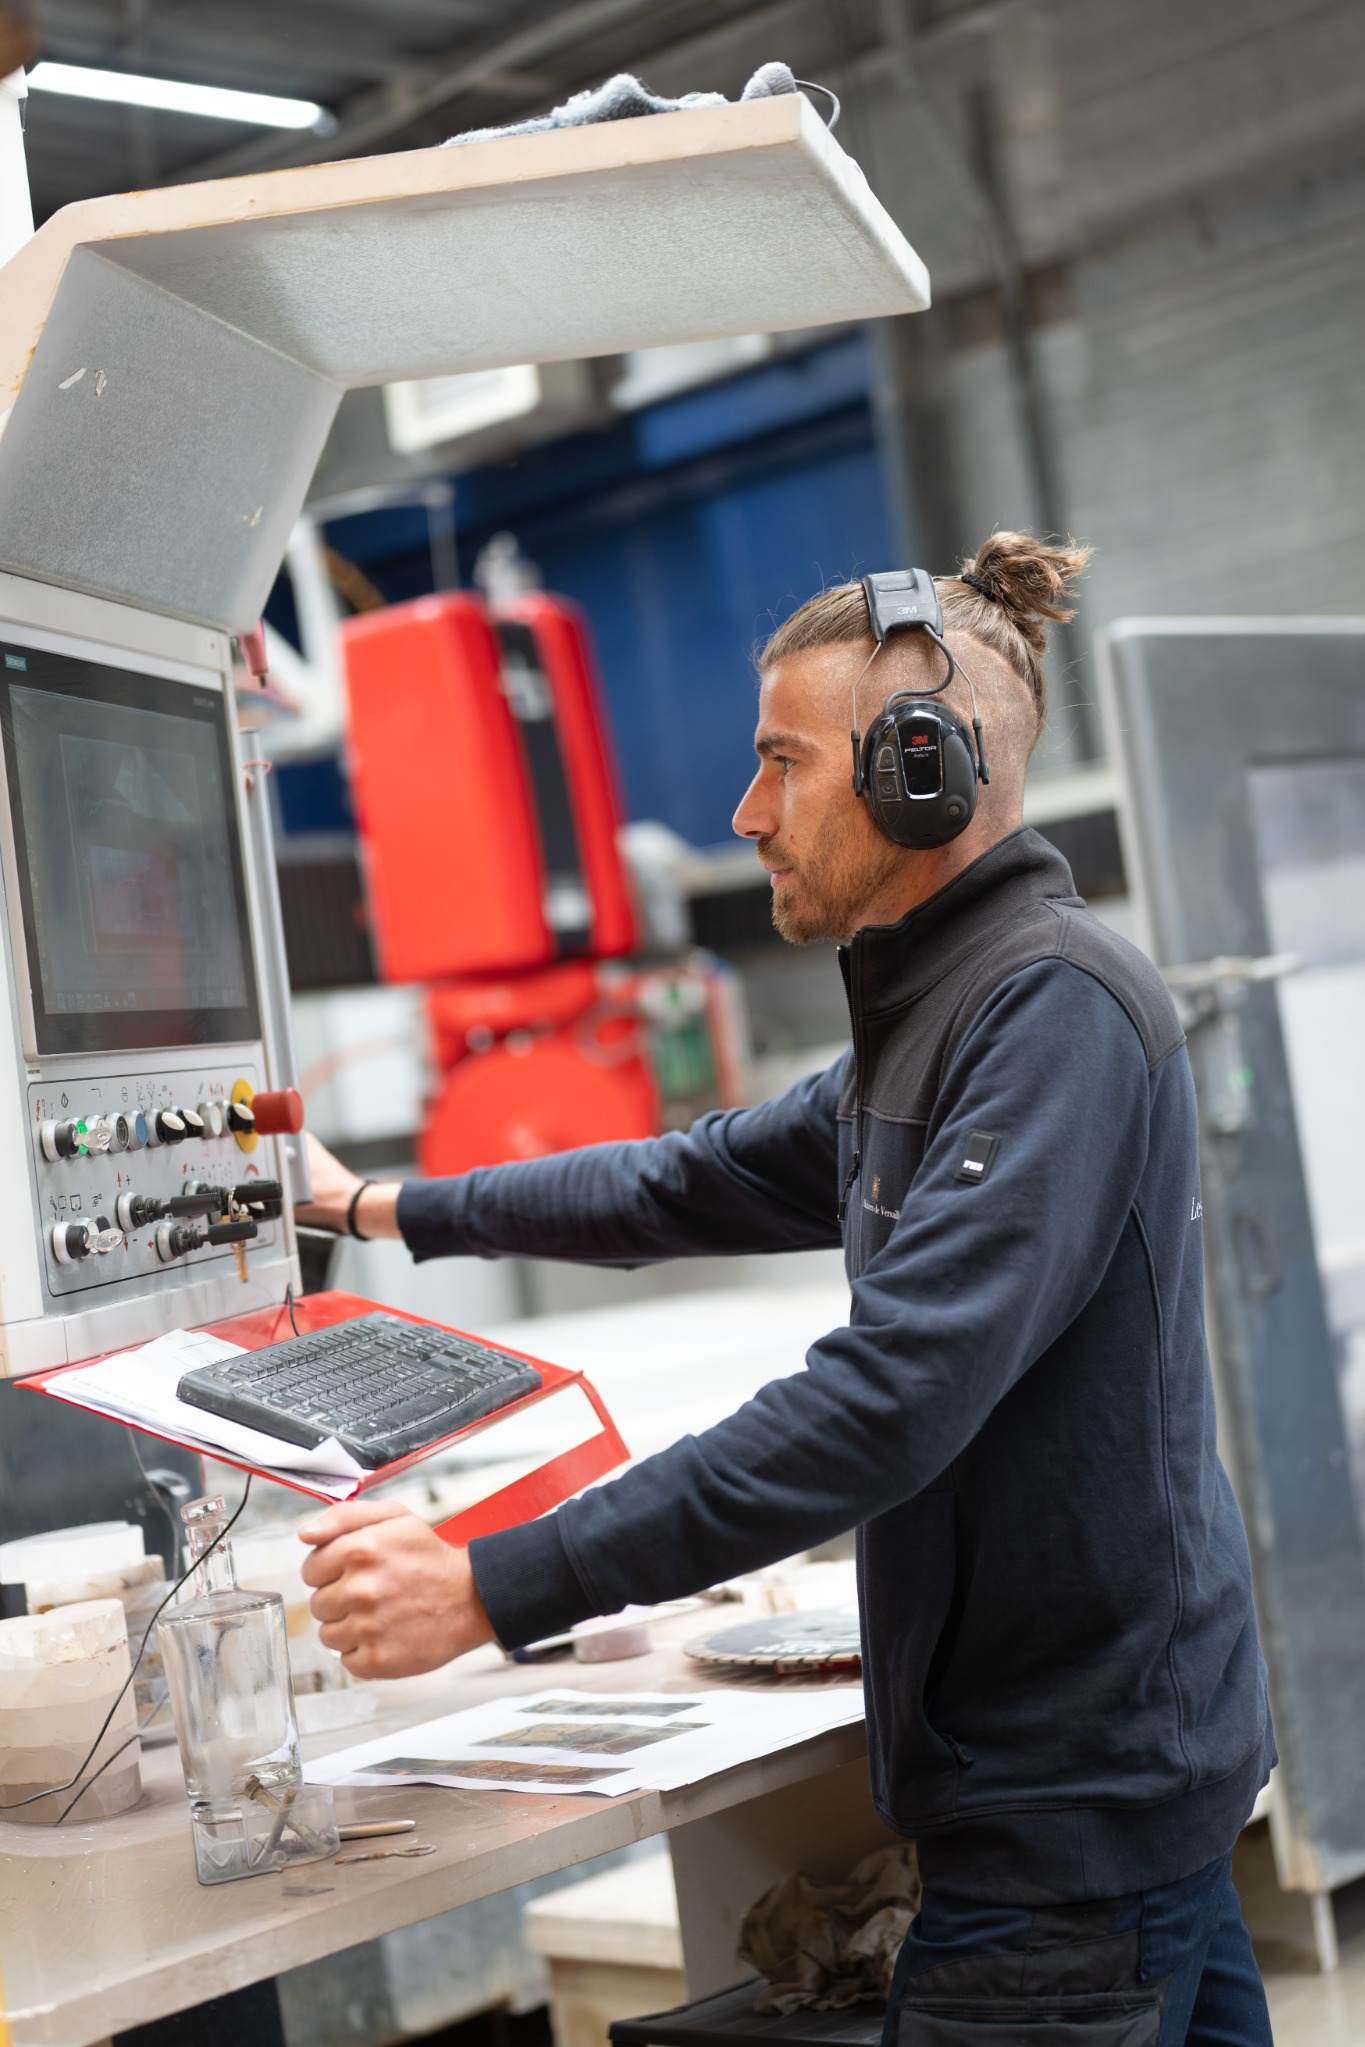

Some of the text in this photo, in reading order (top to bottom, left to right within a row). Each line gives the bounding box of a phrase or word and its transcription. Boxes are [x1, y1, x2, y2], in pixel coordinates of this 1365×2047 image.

[896, 606, 918, 615] 3M
[911, 735, 929, 746] 3M
[904, 745, 937, 753] PELTOR
